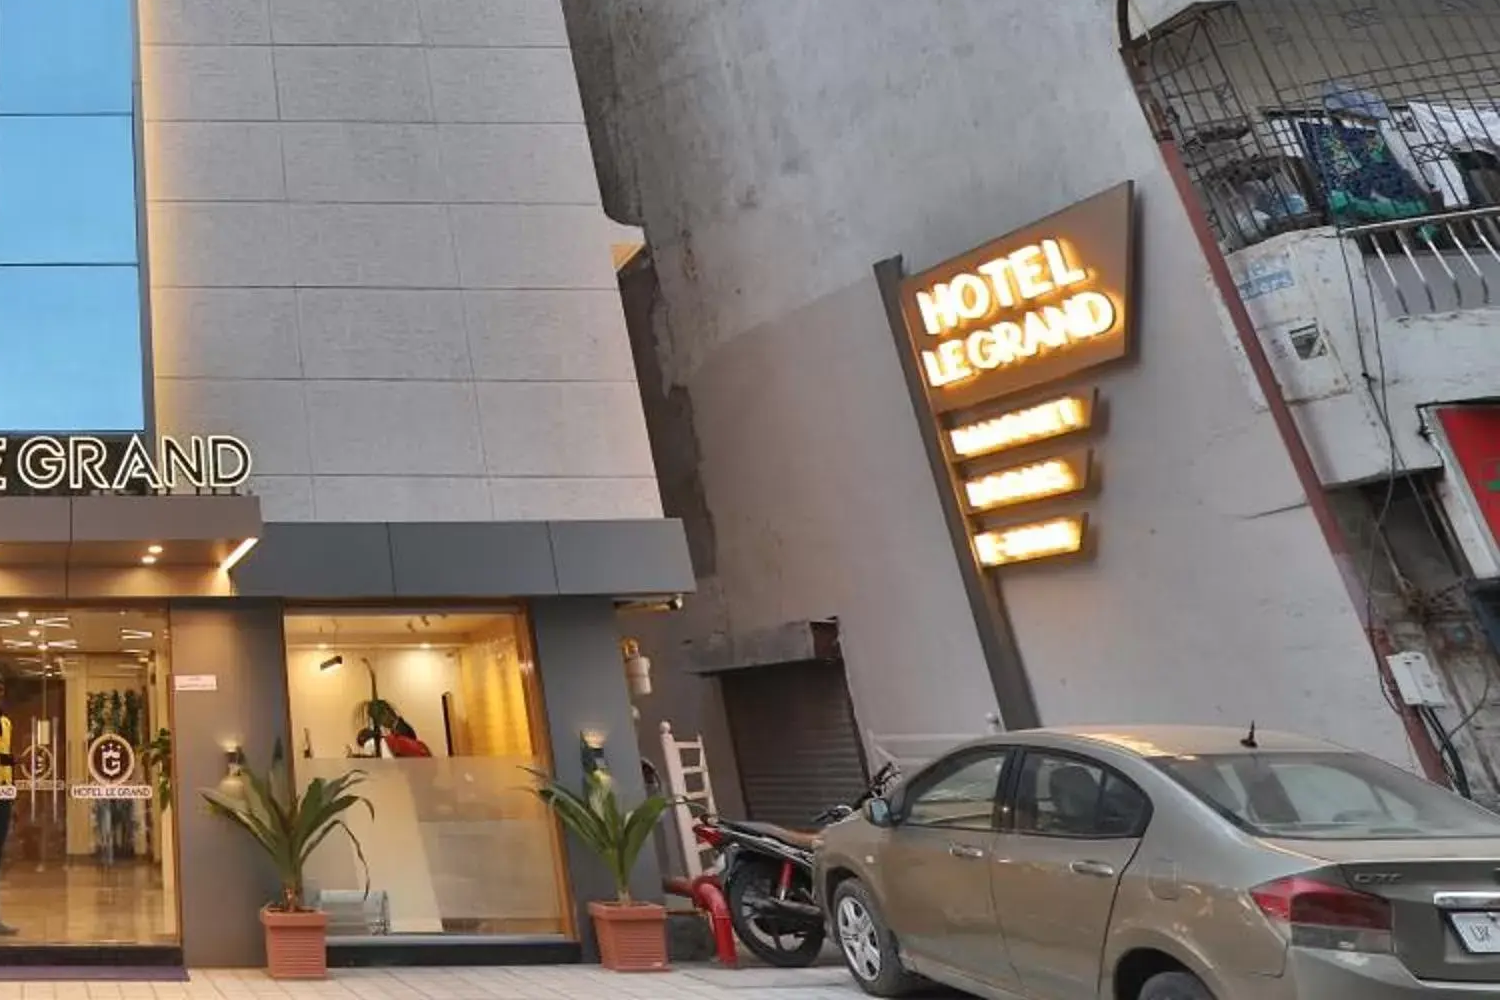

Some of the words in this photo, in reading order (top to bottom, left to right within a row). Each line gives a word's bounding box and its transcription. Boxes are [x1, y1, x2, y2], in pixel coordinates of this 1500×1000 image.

[916, 239, 1087, 335] HOTEL
[921, 339, 973, 387] LE
[966, 291, 1116, 369] GRAND
[17, 433, 251, 489] GRAND
[73, 787, 103, 797] HOTEL
[117, 787, 150, 797] GRAND
